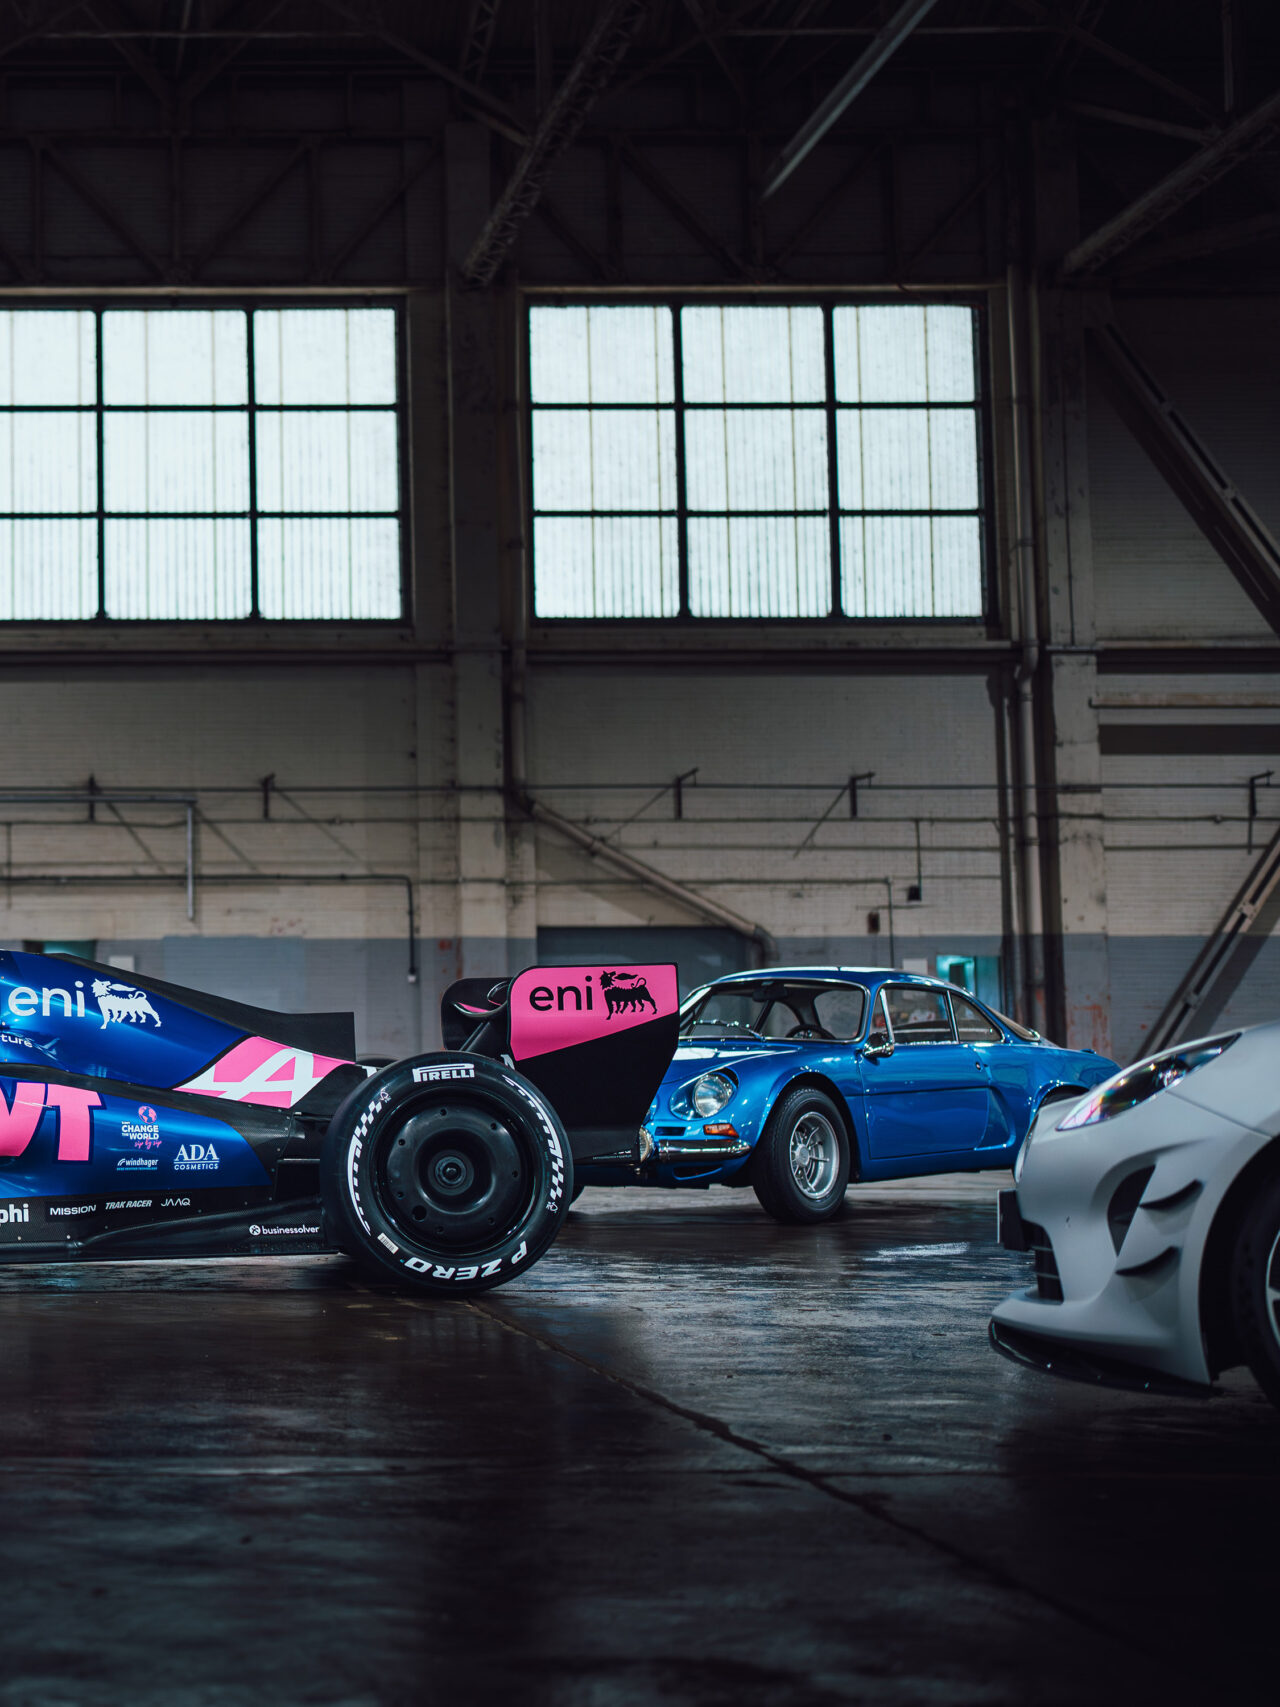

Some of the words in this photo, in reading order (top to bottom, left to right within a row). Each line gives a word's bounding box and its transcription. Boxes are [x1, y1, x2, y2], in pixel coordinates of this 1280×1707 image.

[8, 981, 86, 1018] eni
[529, 976, 593, 1012] eni
[412, 1063, 475, 1082] PIRELLI
[173, 1143, 220, 1161] ADA
[125, 1157, 158, 1168] windhager
[49, 1204, 97, 1216] MISSION
[105, 1201, 126, 1210] TRAK
[126, 1200, 153, 1208] RACER
[262, 1224, 320, 1234] businessolver
[511, 1240, 527, 1265] P
[404, 1257, 503, 1281] ZERO
